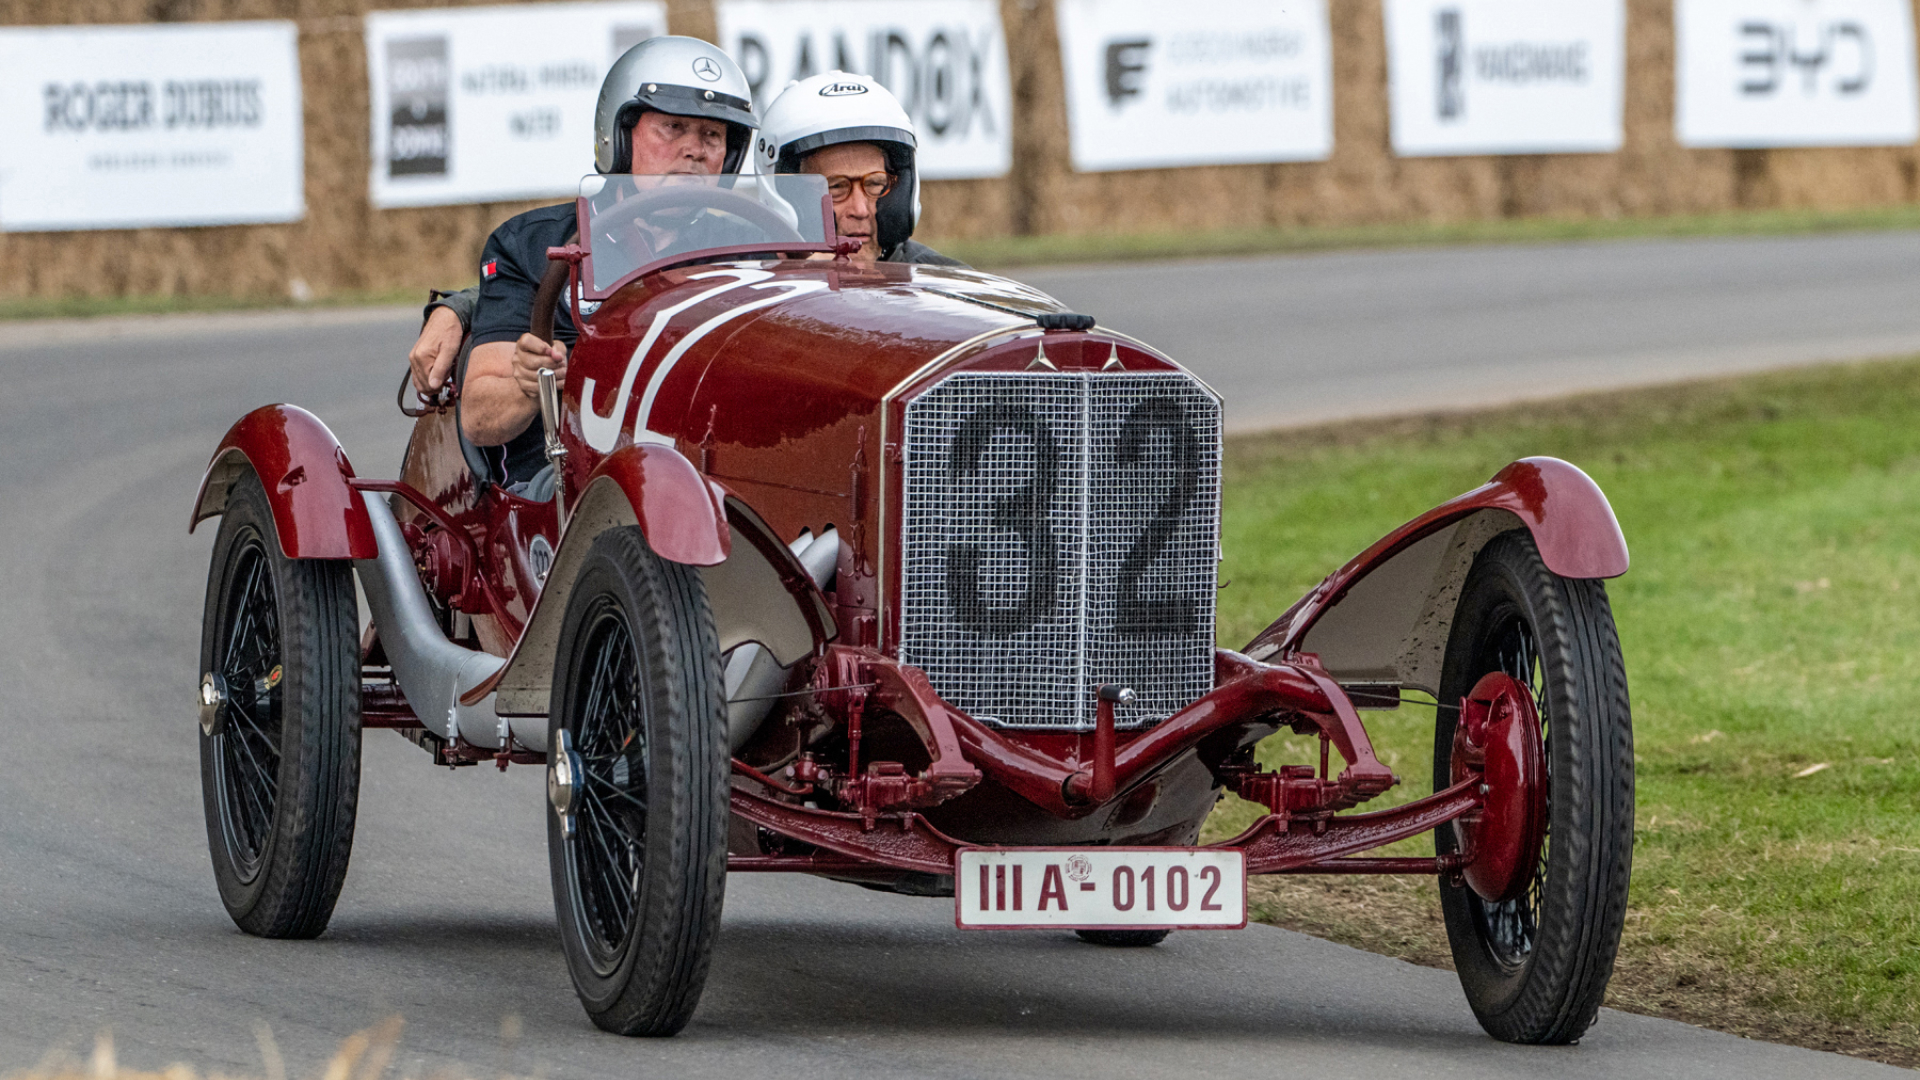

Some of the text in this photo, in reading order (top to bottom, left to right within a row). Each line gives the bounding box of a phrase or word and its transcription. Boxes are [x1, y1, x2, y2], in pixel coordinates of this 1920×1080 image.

[1741, 21, 1873, 94] BYD
[45, 82, 154, 131] ROGER
[824, 83, 863, 95] Arai
[945, 398, 1200, 635] 32
